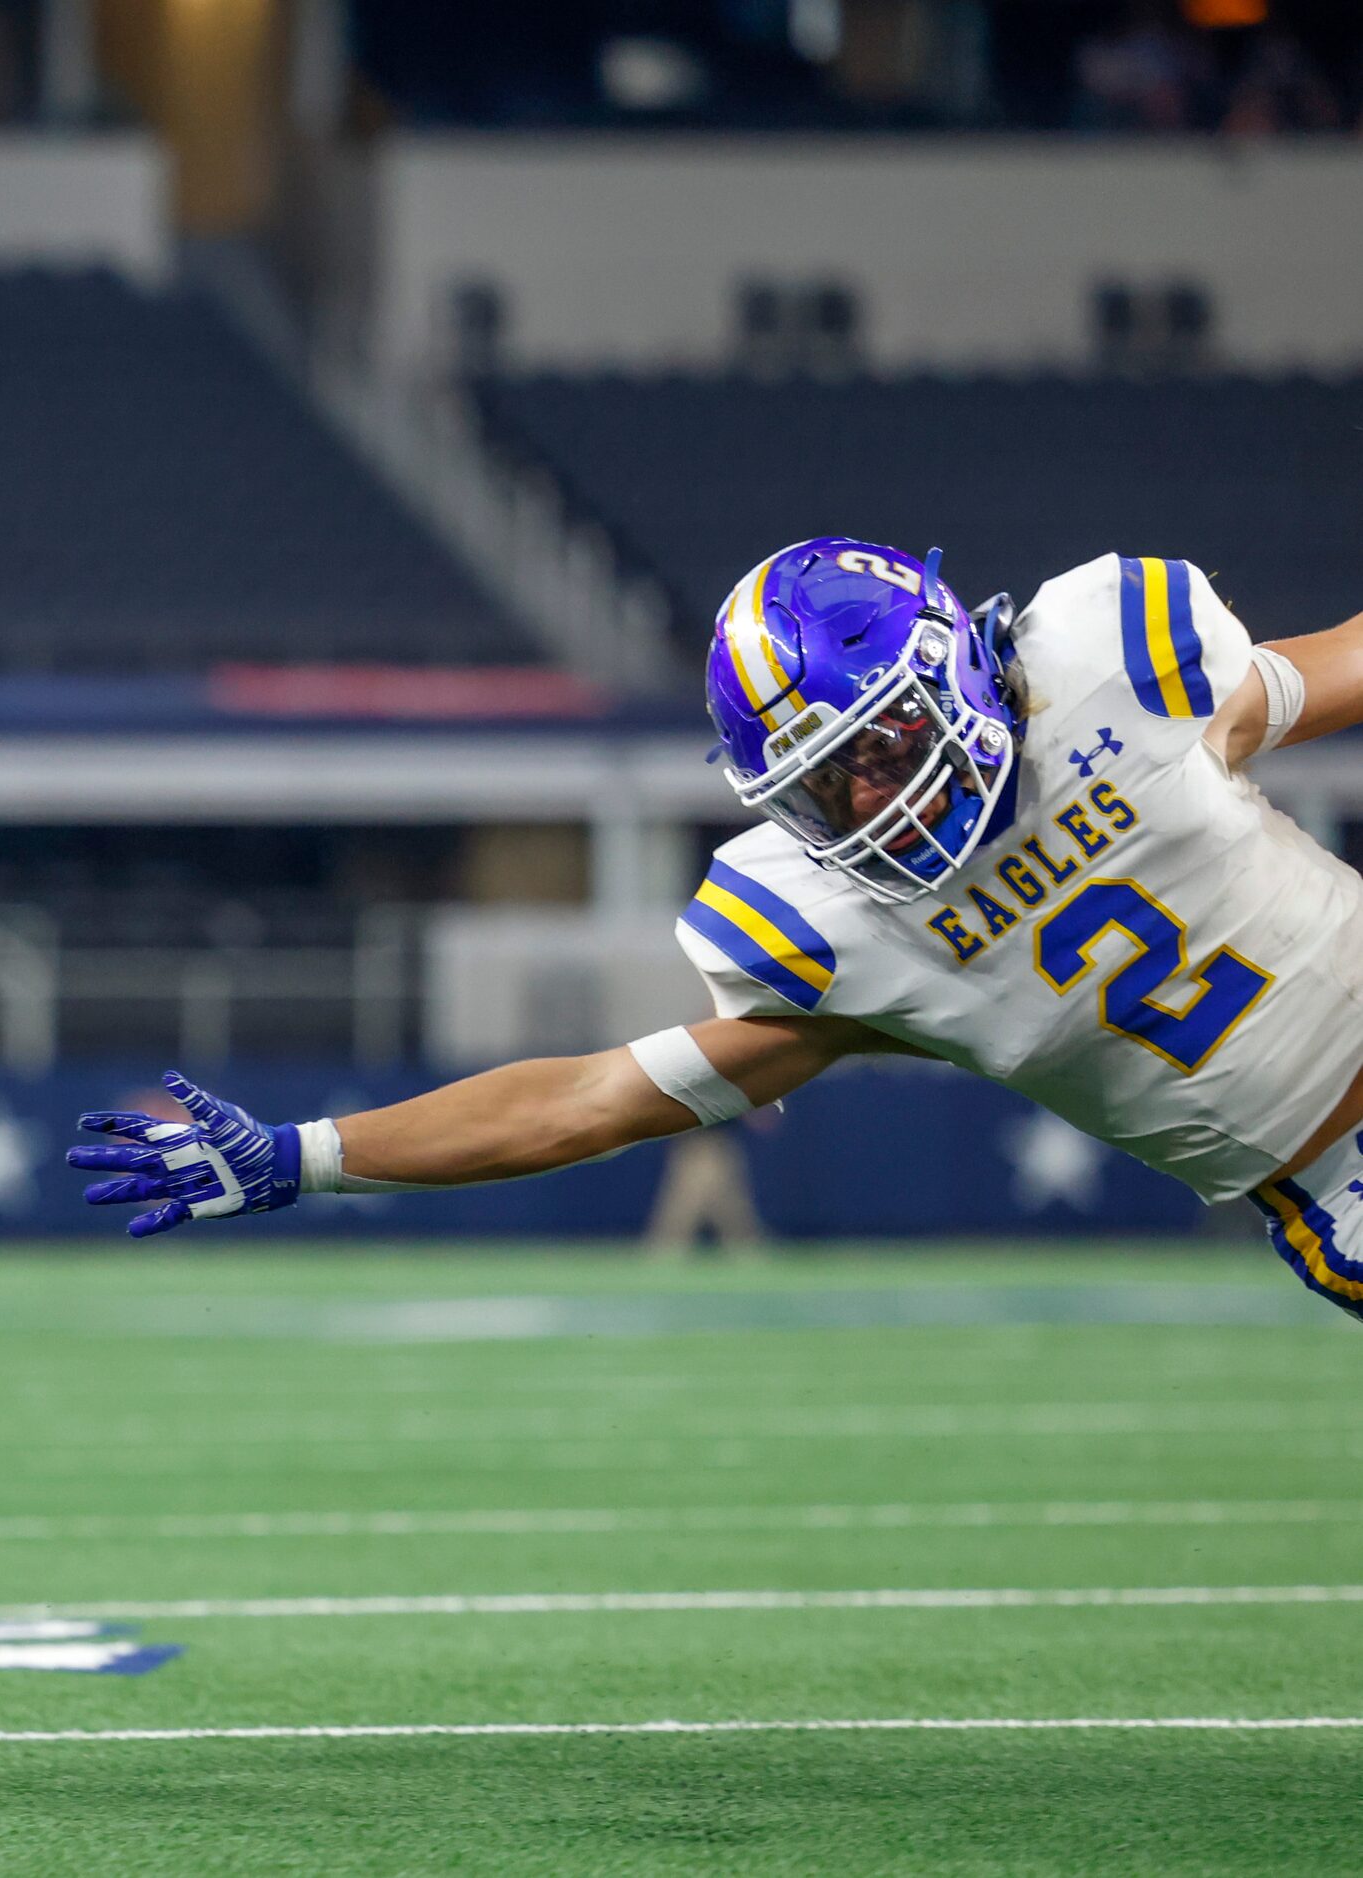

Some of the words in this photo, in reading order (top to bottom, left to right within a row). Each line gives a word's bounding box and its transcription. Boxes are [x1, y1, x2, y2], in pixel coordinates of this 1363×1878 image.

[836, 549, 922, 596] 2
[910, 846, 937, 866] Ridde
[925, 779, 1139, 966] EAGLES
[1033, 877, 1276, 1077] 2
